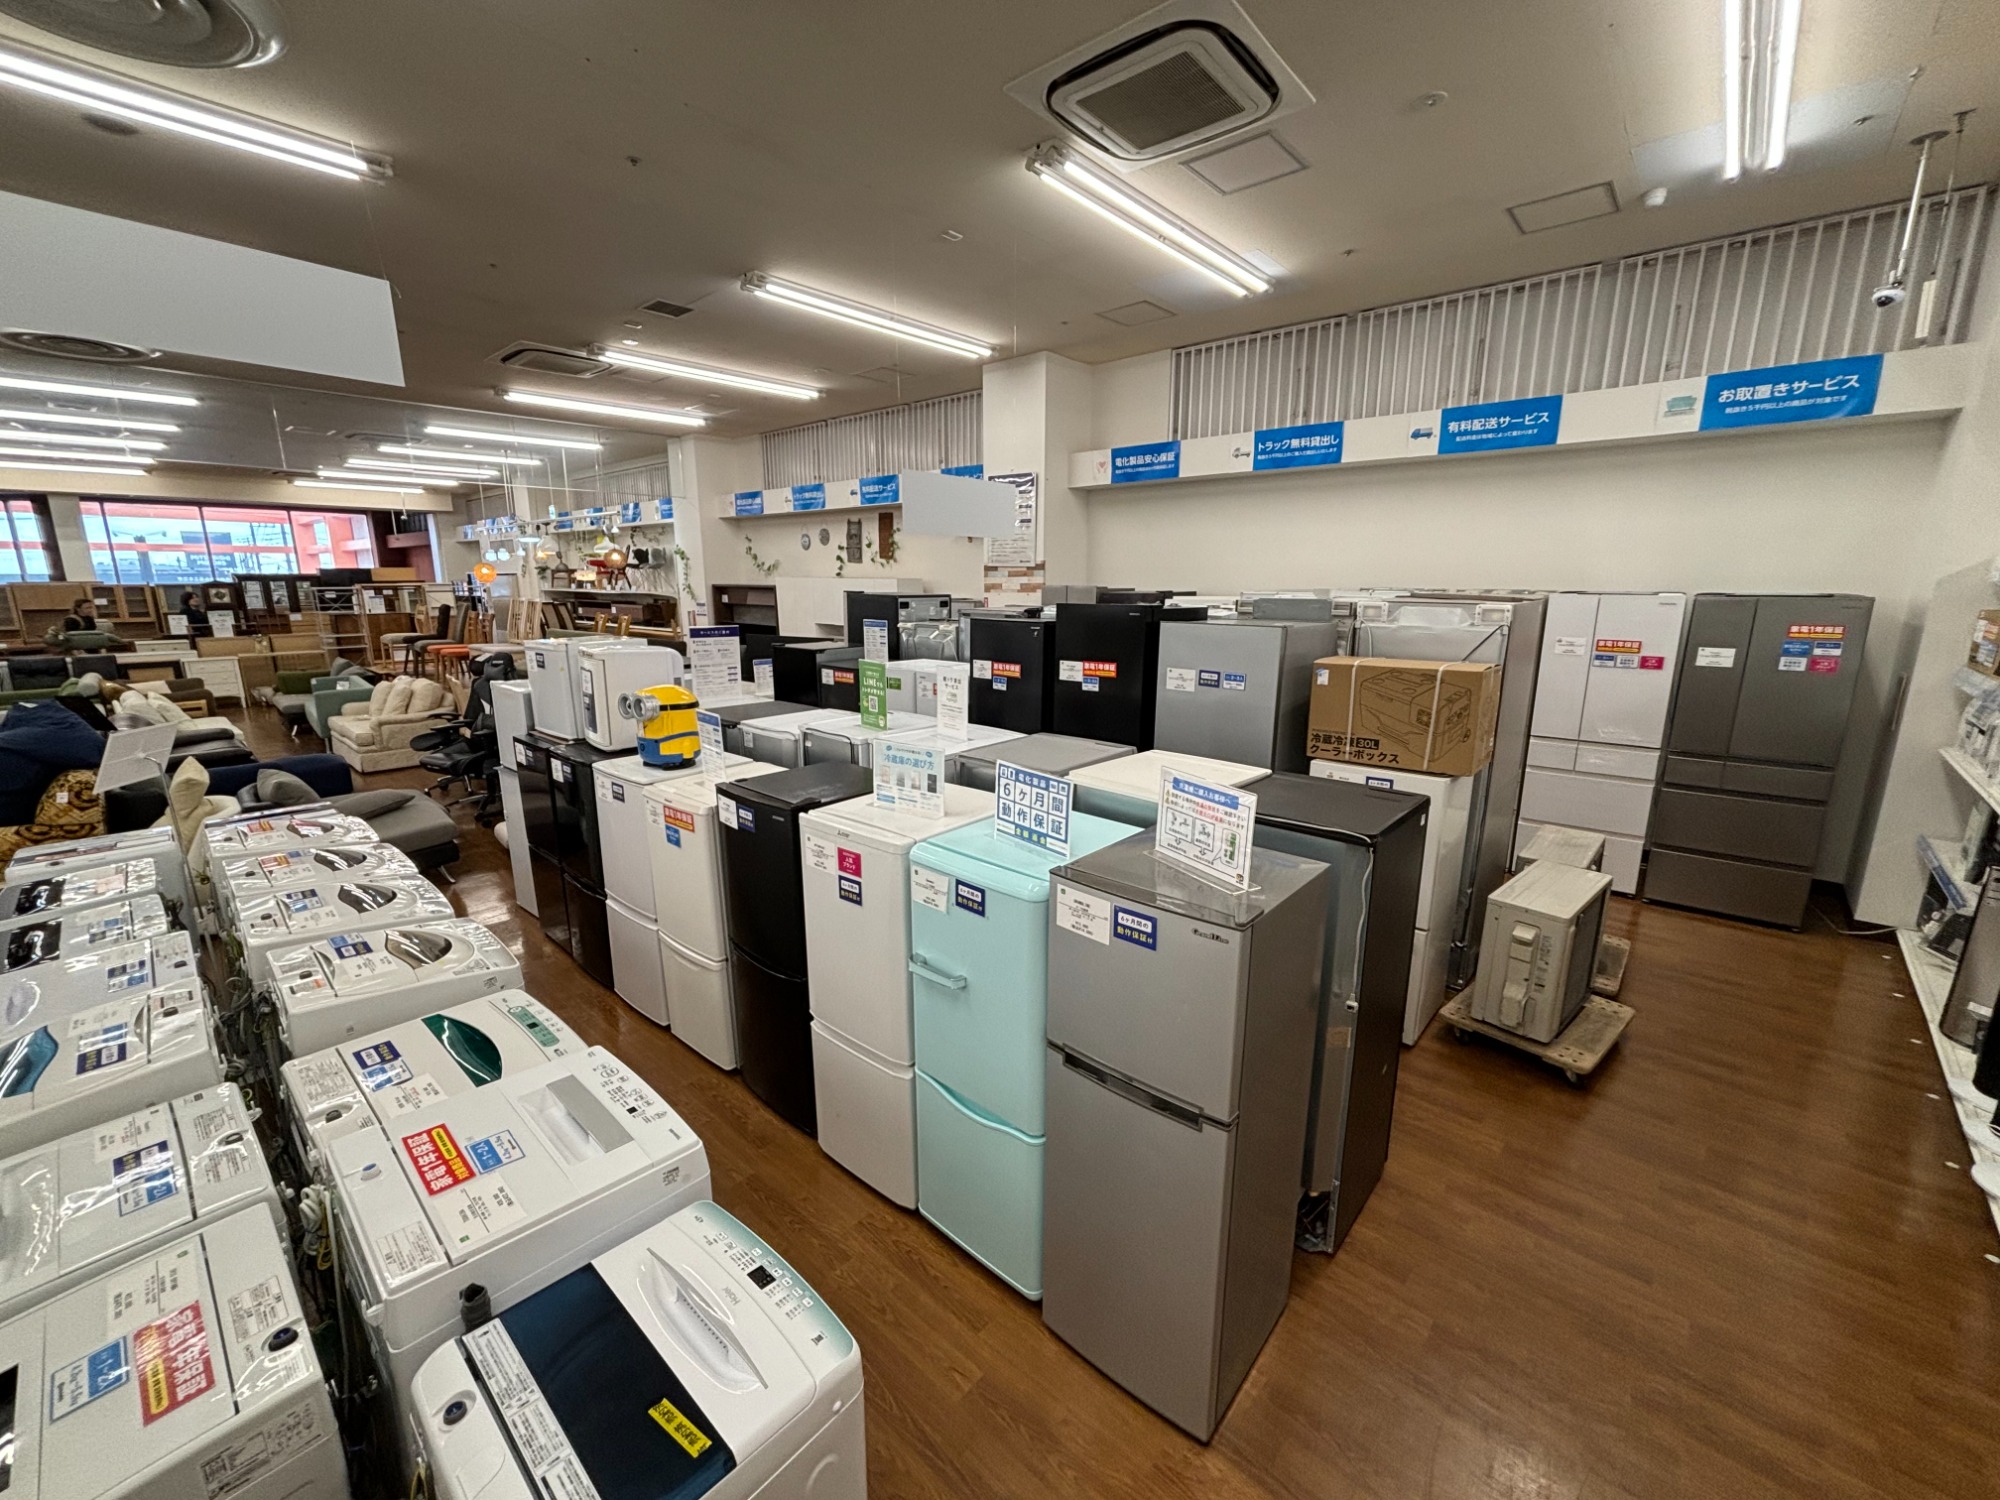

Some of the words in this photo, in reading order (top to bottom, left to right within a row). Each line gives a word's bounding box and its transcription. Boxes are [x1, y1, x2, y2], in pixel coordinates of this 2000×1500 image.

[1718, 374, 1860, 403] お取置きサービス
[1448, 412, 1549, 433] 有料配送サービス
[1258, 435, 1339, 452] トラック無料貸出し
[1115, 451, 1176, 467] 電化製品安心保証
[1310, 743, 1400, 764] クーラーボックス
[1357, 740, 1378, 749] 30L
[884, 754, 935, 771] 冷蔵庫の選び方
[1018, 773, 1047, 789] 電化製品
[1001, 802, 1064, 837] 動作保証
[1117, 926, 1153, 945] 動作保証付
[406, 1132, 453, 1191] 家電1年保証
[722, 1287, 741, 1306] Haier
[165, 1308, 208, 1402] 家電1年保証
